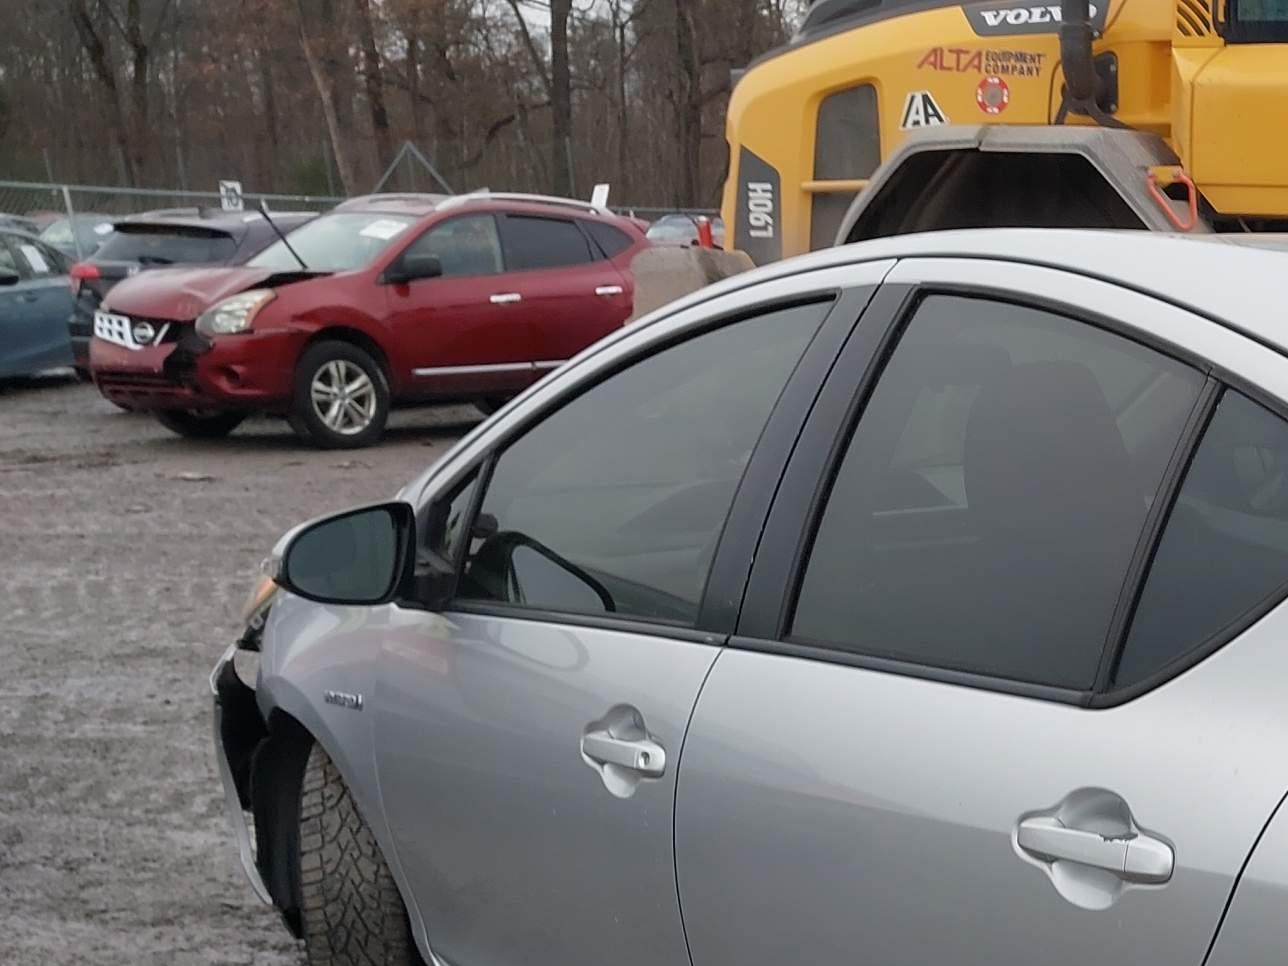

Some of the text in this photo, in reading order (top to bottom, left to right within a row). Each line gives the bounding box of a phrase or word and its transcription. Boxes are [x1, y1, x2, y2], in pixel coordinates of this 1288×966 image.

[917, 47, 982, 74] ALTA
[985, 50, 1043, 65] EQUIPMENT
[985, 63, 1041, 77] COMPANY
[748, 182, 773, 238] L90H
